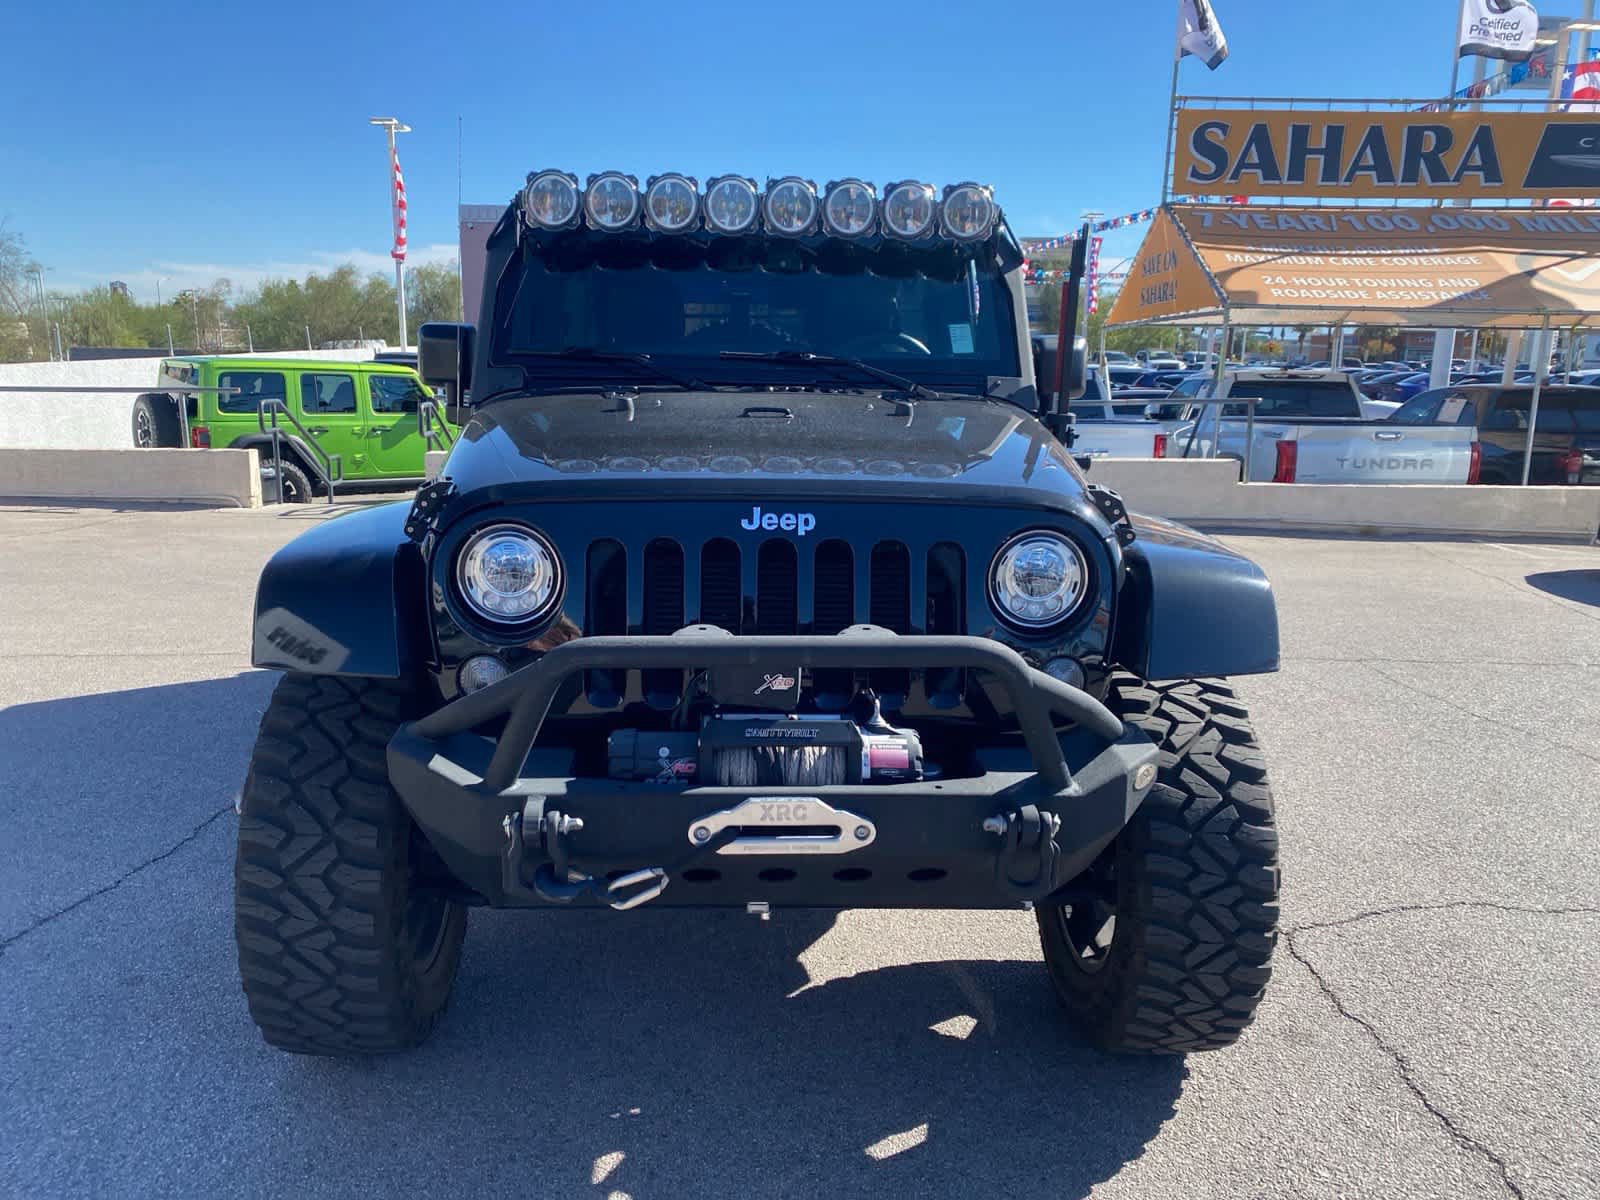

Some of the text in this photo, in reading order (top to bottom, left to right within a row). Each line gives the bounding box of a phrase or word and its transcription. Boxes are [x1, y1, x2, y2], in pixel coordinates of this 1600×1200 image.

[1187, 119, 1504, 188] SAHARA
[1143, 253, 1161, 276] SAVE
[1225, 252, 1482, 266] MAXIMUM CARE COVERAGE
[1261, 275, 1481, 289] 24-HOUR TOWING AND
[1270, 287, 1489, 301] ROADSIDE ASSISTANCE
[1336, 457, 1434, 470] TUNDRA
[741, 506, 816, 536] Jeep
[759, 803, 808, 822] XRC
